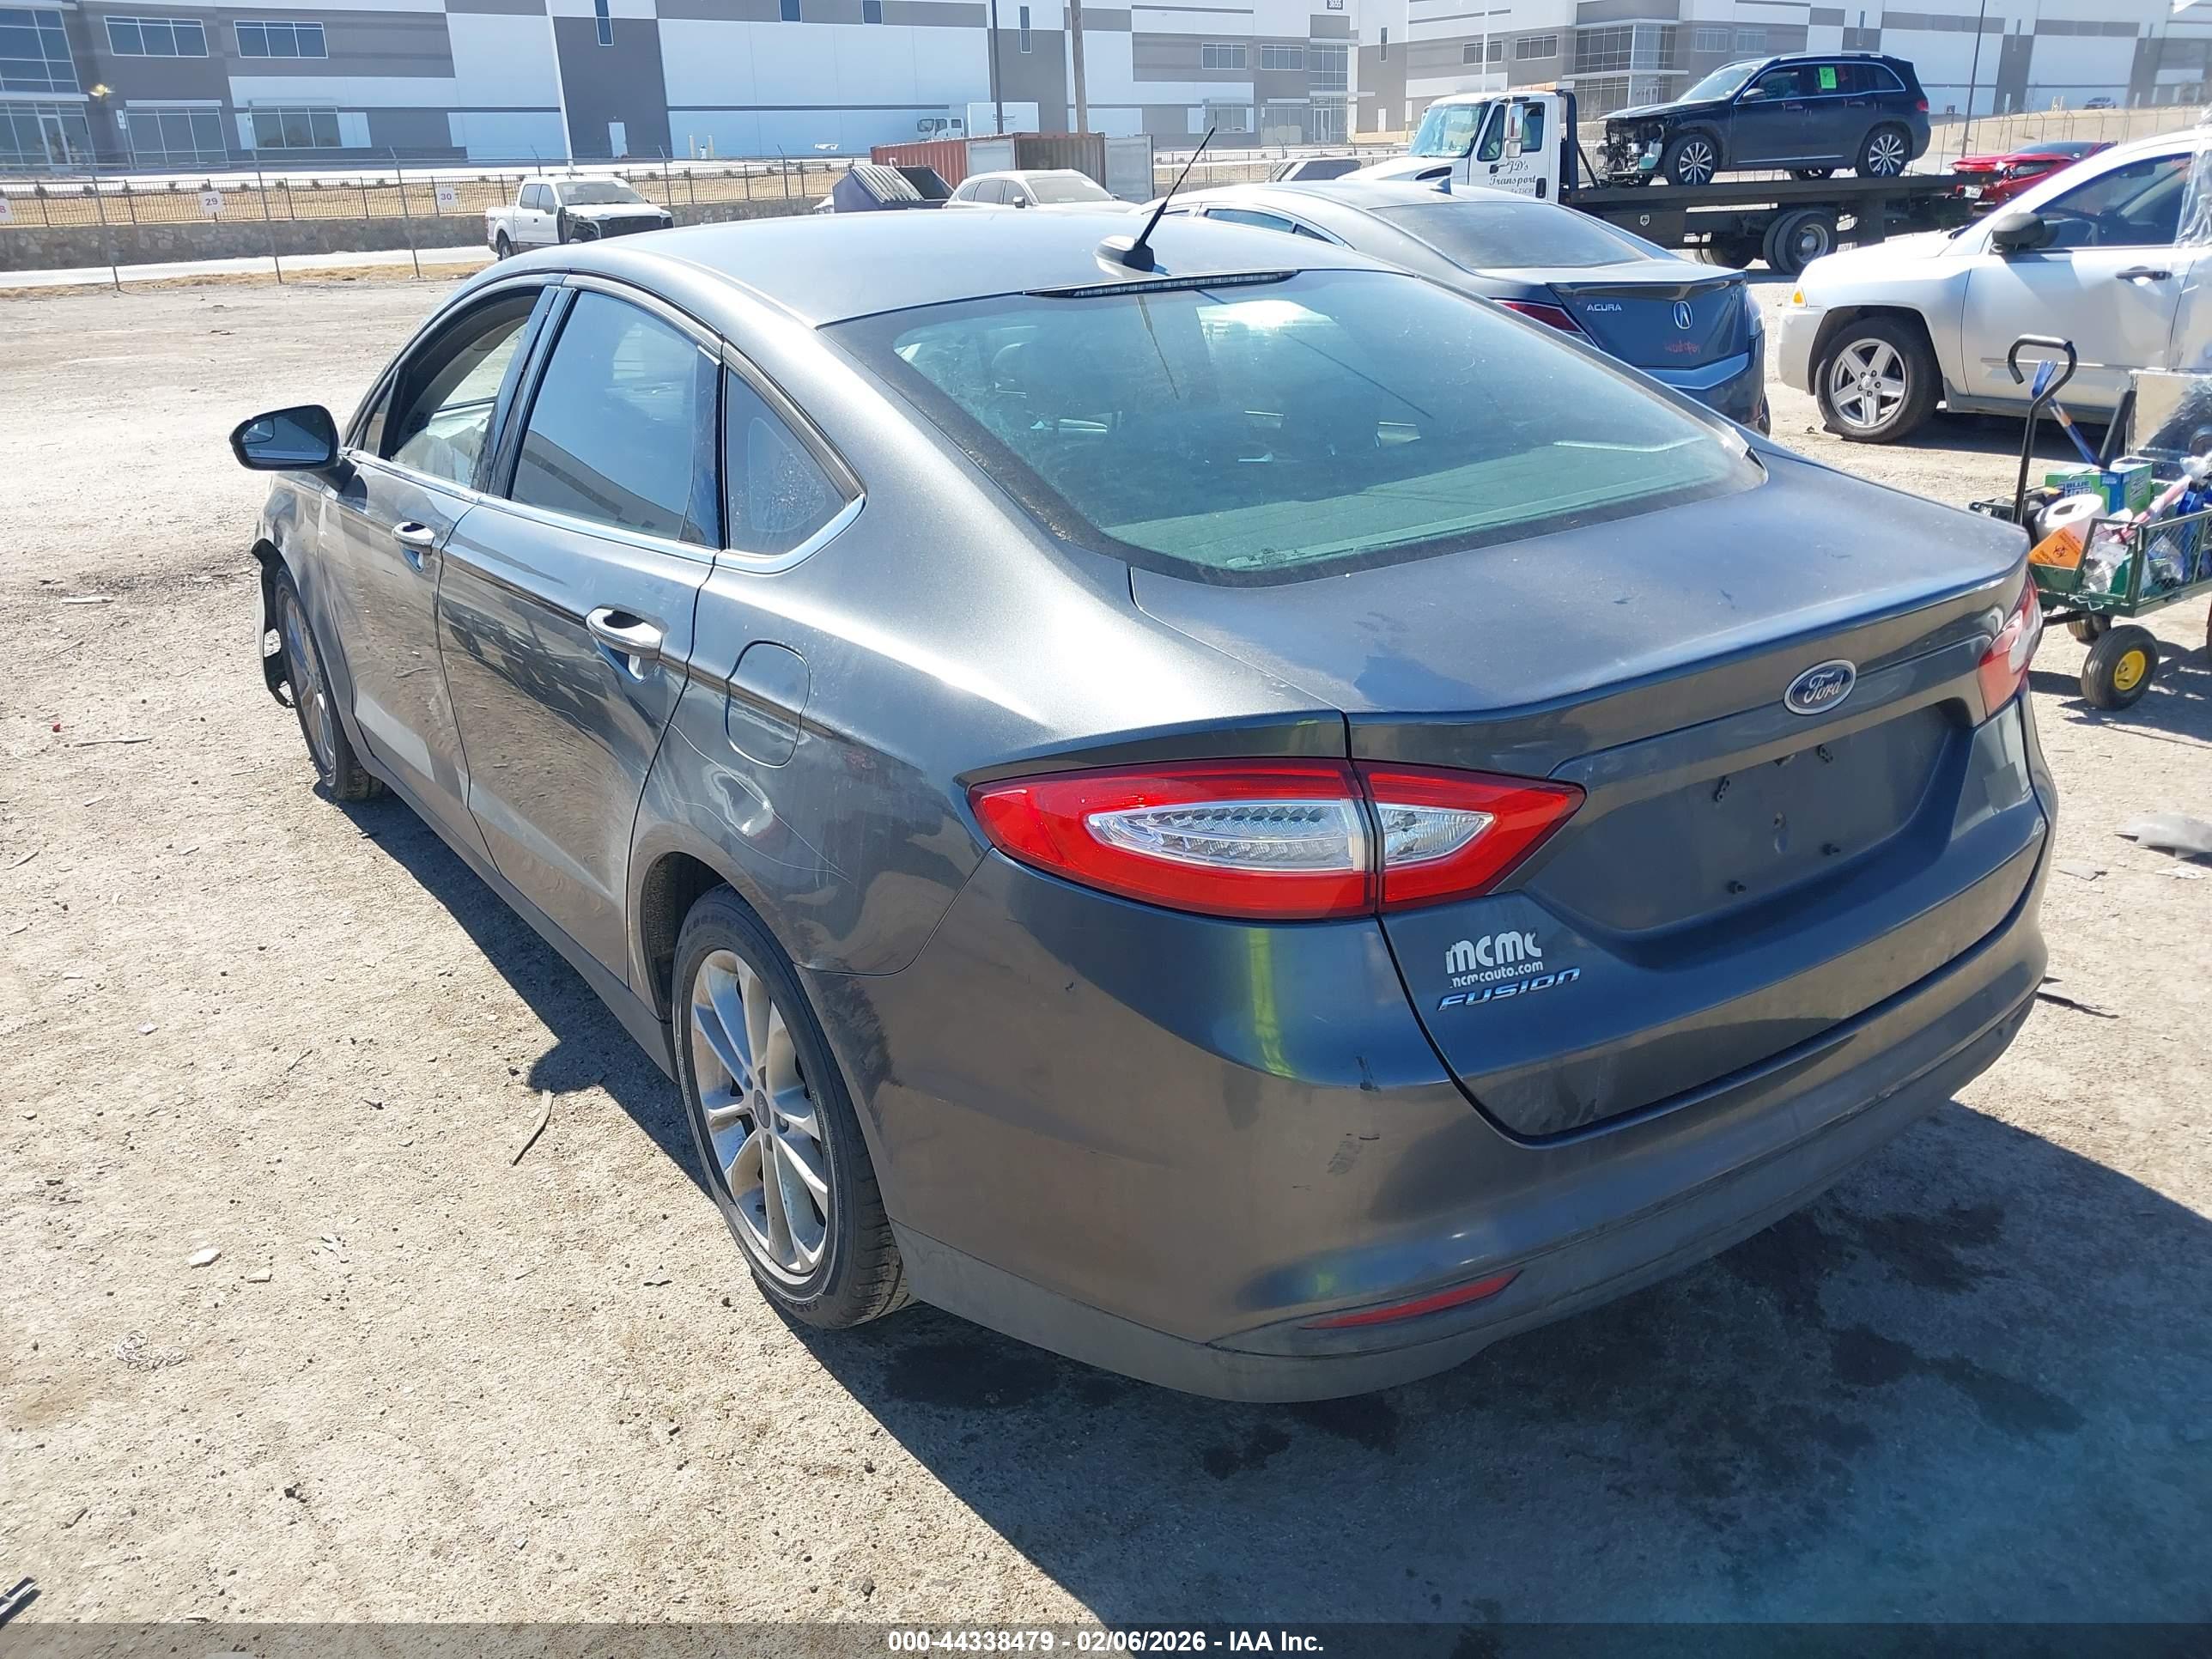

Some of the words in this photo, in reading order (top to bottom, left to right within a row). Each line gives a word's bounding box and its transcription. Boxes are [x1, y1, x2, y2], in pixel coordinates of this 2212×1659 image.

[1508, 161, 1528, 173] JD's
[1489, 175, 1536, 187] Transport
[205, 198, 218, 206] 29
[1586, 303, 1622, 312] ACURA
[1802, 672, 1844, 704] Ford
[1437, 967, 1581, 1012] FUSION
